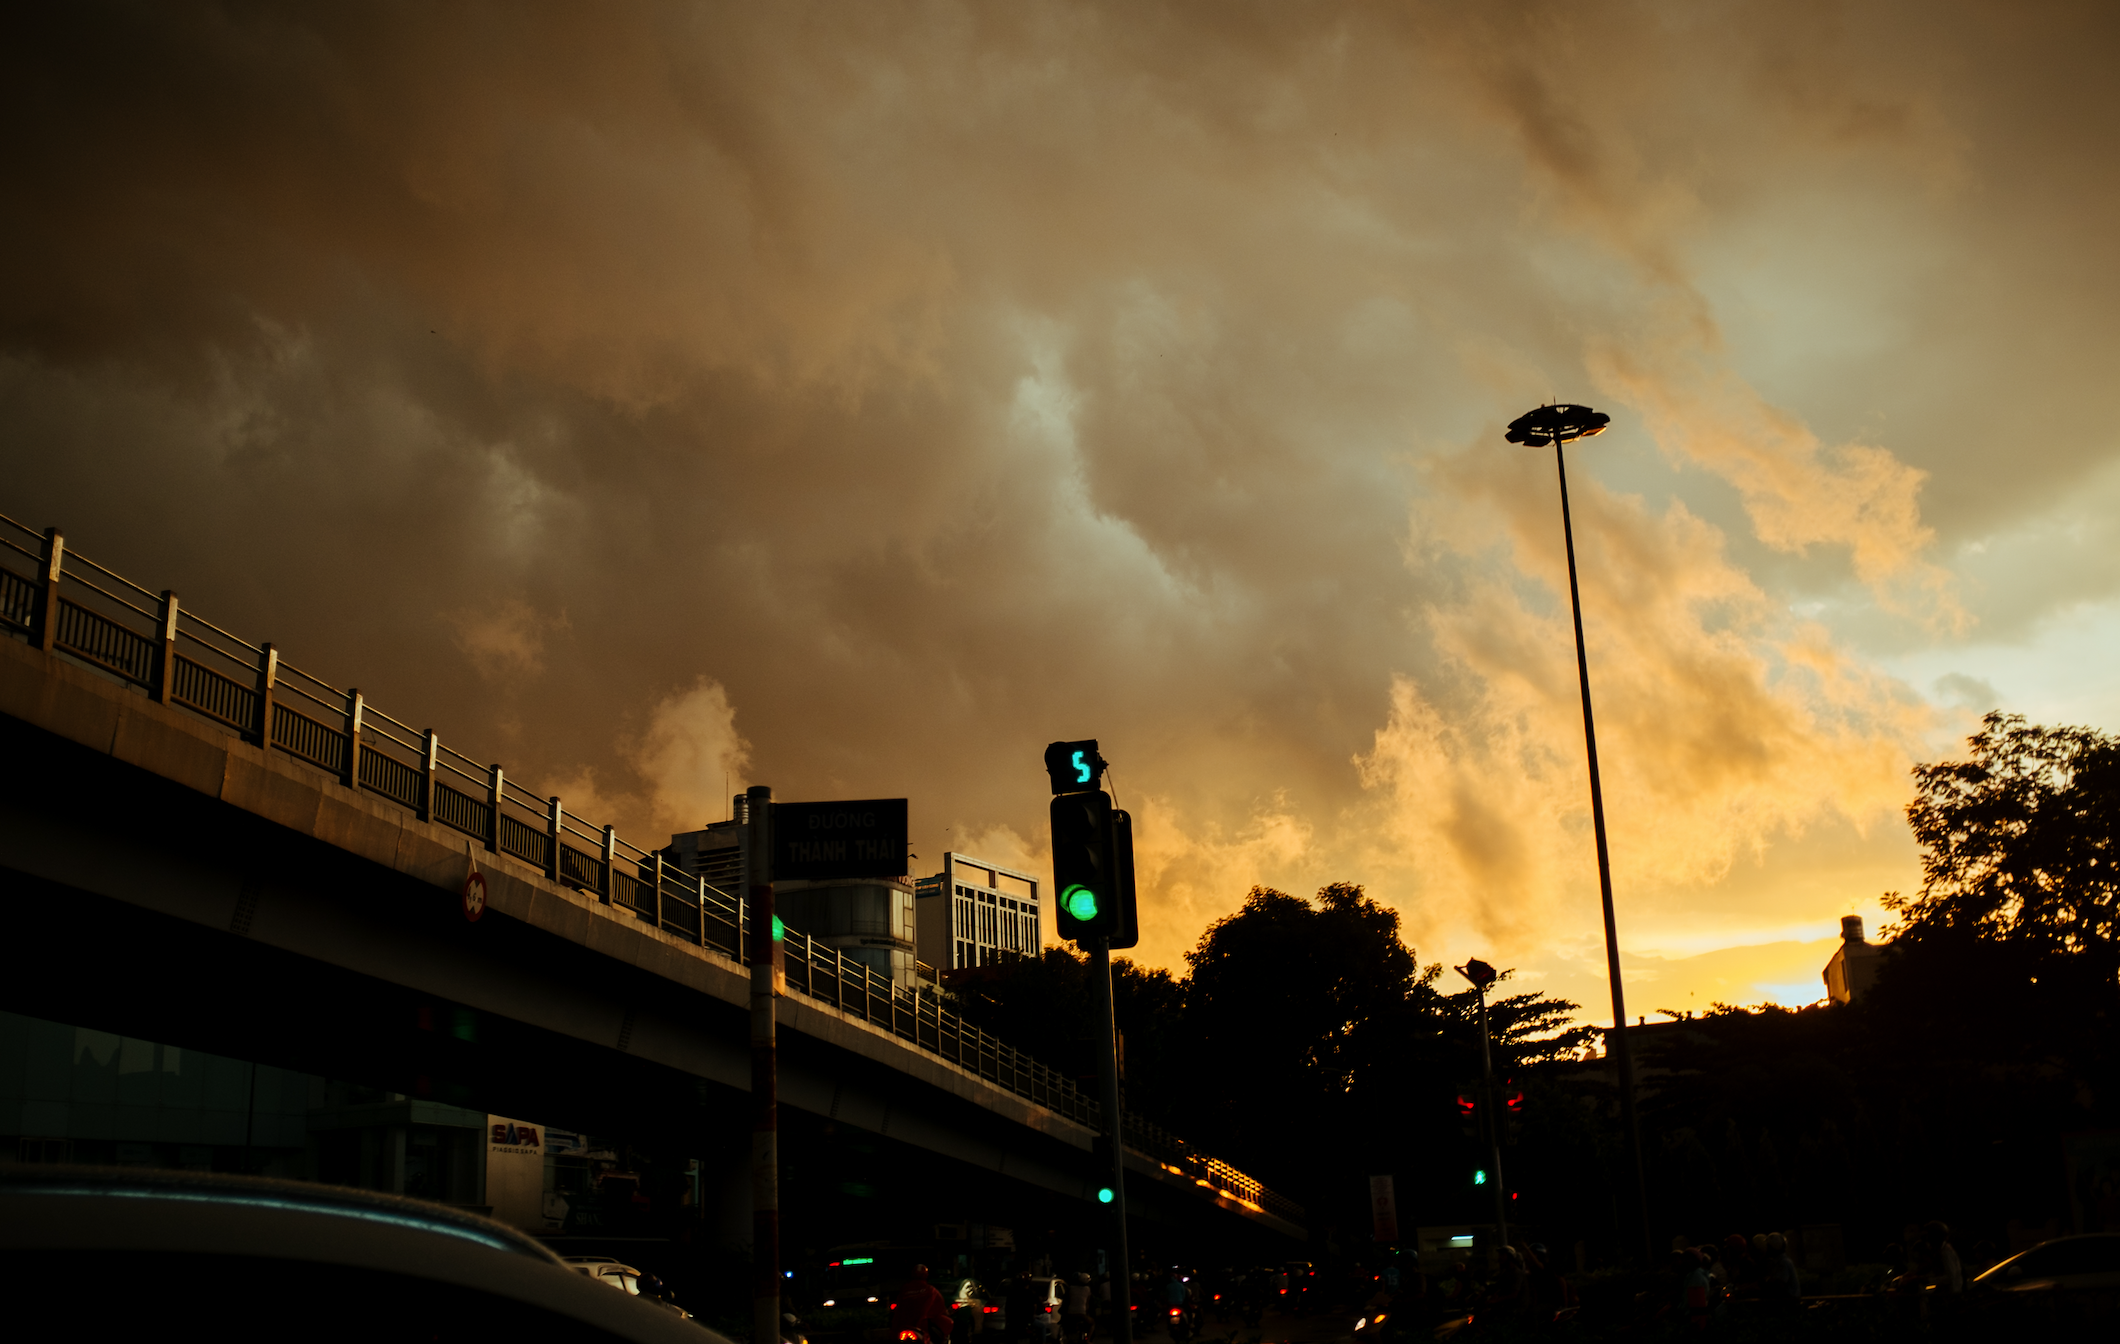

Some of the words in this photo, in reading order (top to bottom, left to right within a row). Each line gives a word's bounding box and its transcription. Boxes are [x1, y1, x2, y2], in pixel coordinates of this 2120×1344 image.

[808, 809, 876, 830] ĐƯỜNG
[788, 835, 847, 863] THÀNH
[855, 833, 896, 861] THÁI
[492, 1123, 540, 1147] SAPA
